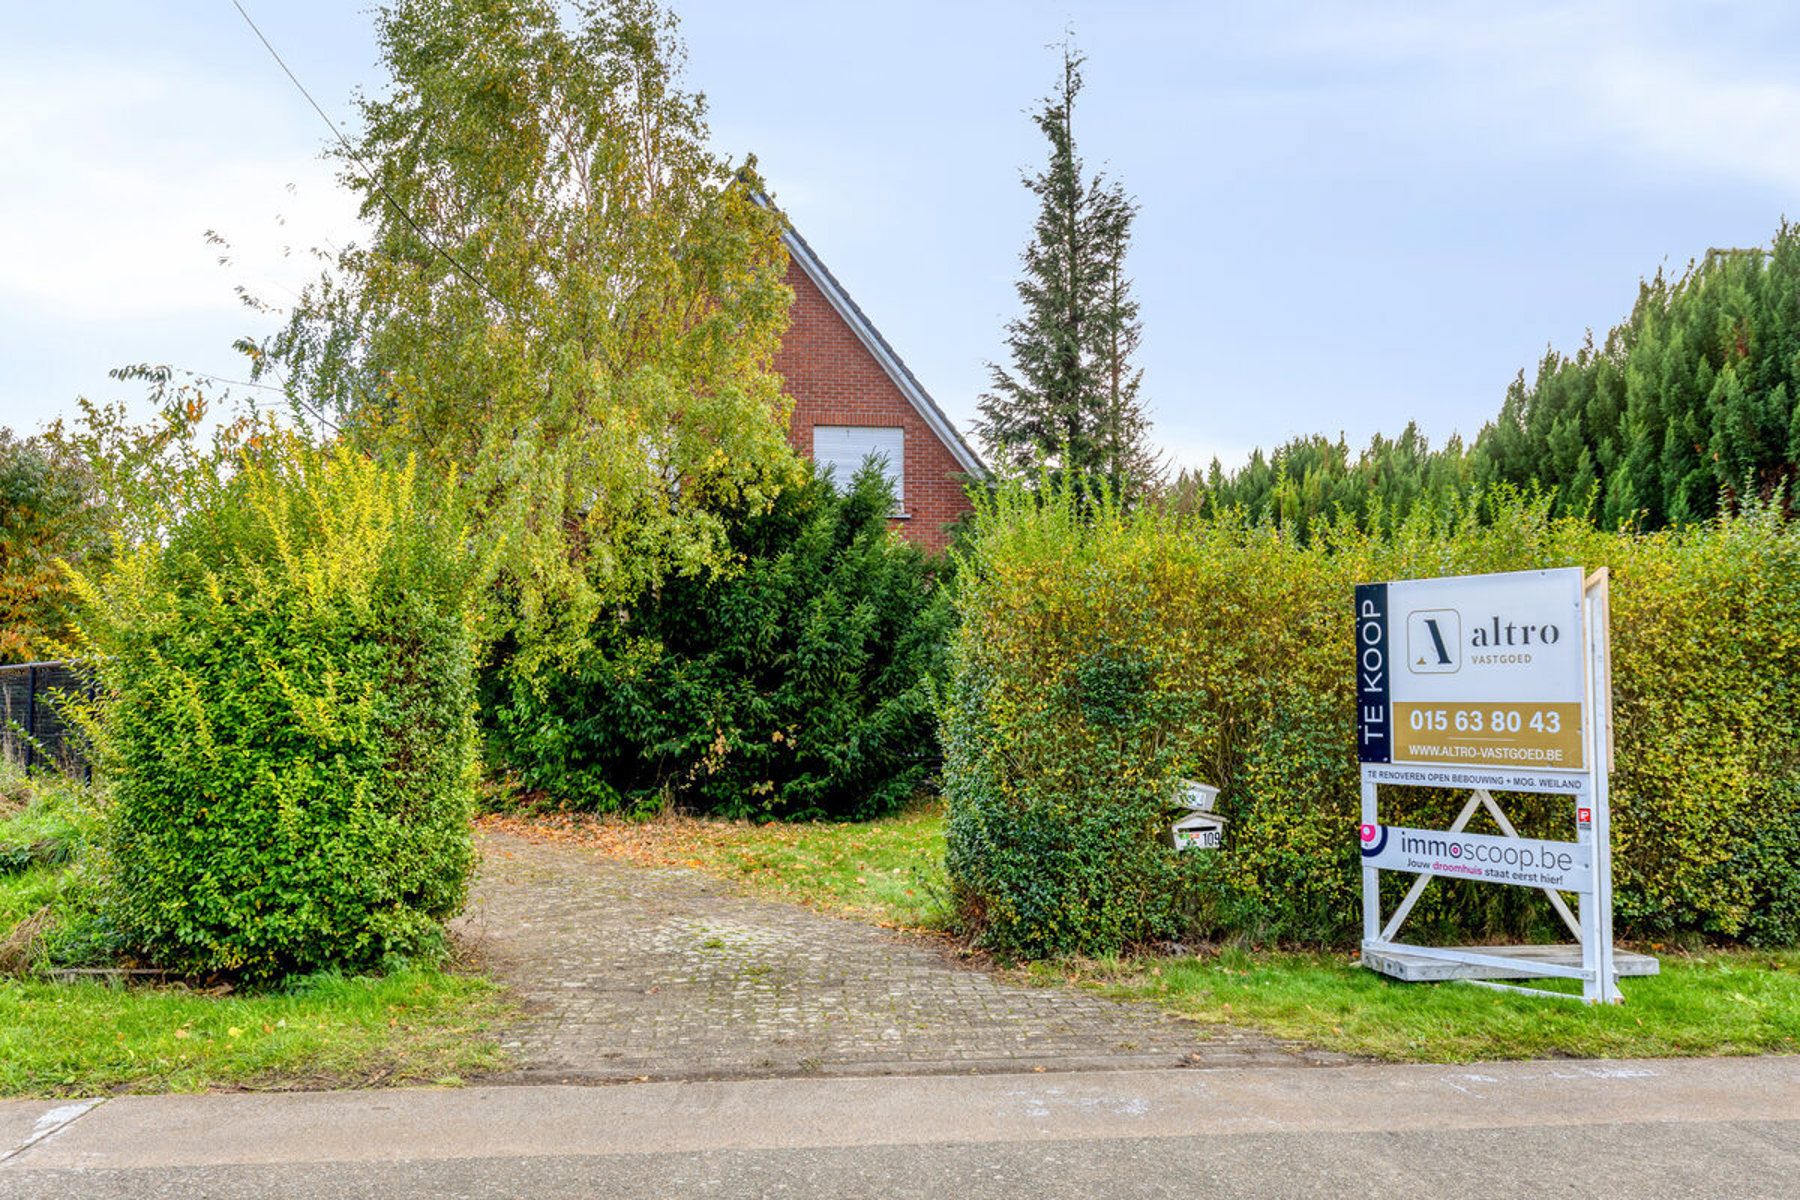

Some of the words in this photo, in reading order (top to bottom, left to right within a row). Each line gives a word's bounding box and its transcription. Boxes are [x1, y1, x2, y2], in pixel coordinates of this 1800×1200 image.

[1471, 616, 1560, 647] altro
[1362, 599, 1383, 692] KOOP
[1471, 653, 1533, 665] VASTGOED
[1364, 705, 1384, 745] TE
[1410, 709, 1448, 731] 015
[1454, 710, 1484, 732] 63
[1491, 710, 1522, 733] 80
[1529, 711, 1561, 734] 43
[1408, 744, 1563, 762] WWW.ALTRO-VASTGOED.BE
[1368, 770, 1377, 778] TE
[1378, 770, 1426, 781] RENOVEREN
[1427, 773, 1450, 783] OPEN
[1451, 774, 1504, 786] BEBOUWING
[1513, 777, 1536, 787] MOG.
[1538, 778, 1582, 790] WEILAND
[1203, 832, 1220, 846] 109
[1401, 831, 1573, 872] immoscoop.be
[1407, 858, 1431, 870] Jouw
[1432, 861, 1483, 876] droomhuis
[1484, 867, 1510, 880] staat
[1512, 870, 1538, 883] eerst
[1539, 873, 1563, 886] hier!
